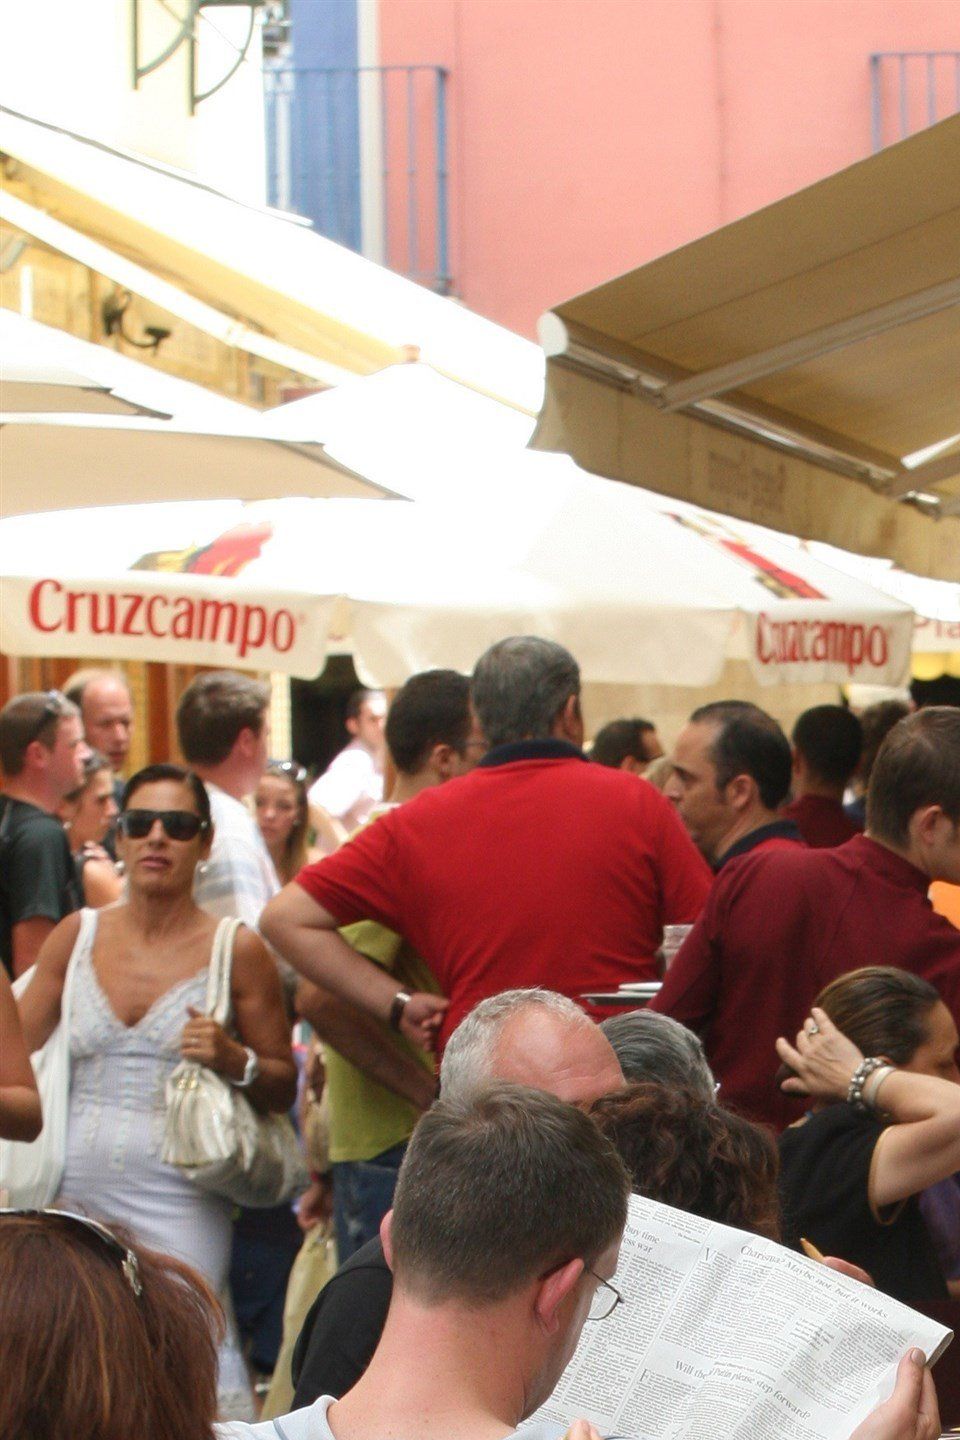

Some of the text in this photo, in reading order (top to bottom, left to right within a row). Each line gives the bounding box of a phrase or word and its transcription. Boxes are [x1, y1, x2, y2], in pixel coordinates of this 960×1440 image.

[28, 578, 296, 658] Cruzcampo
[637, 1242, 653, 1254] war
[642, 1230, 660, 1244] time
[740, 1244, 785, 1266] Charisma?
[786, 1258, 815, 1281] Maybe
[860, 1302, 889, 1319] works
[674, 1359, 694, 1376] Will
[773, 1389, 811, 1420] forward?
